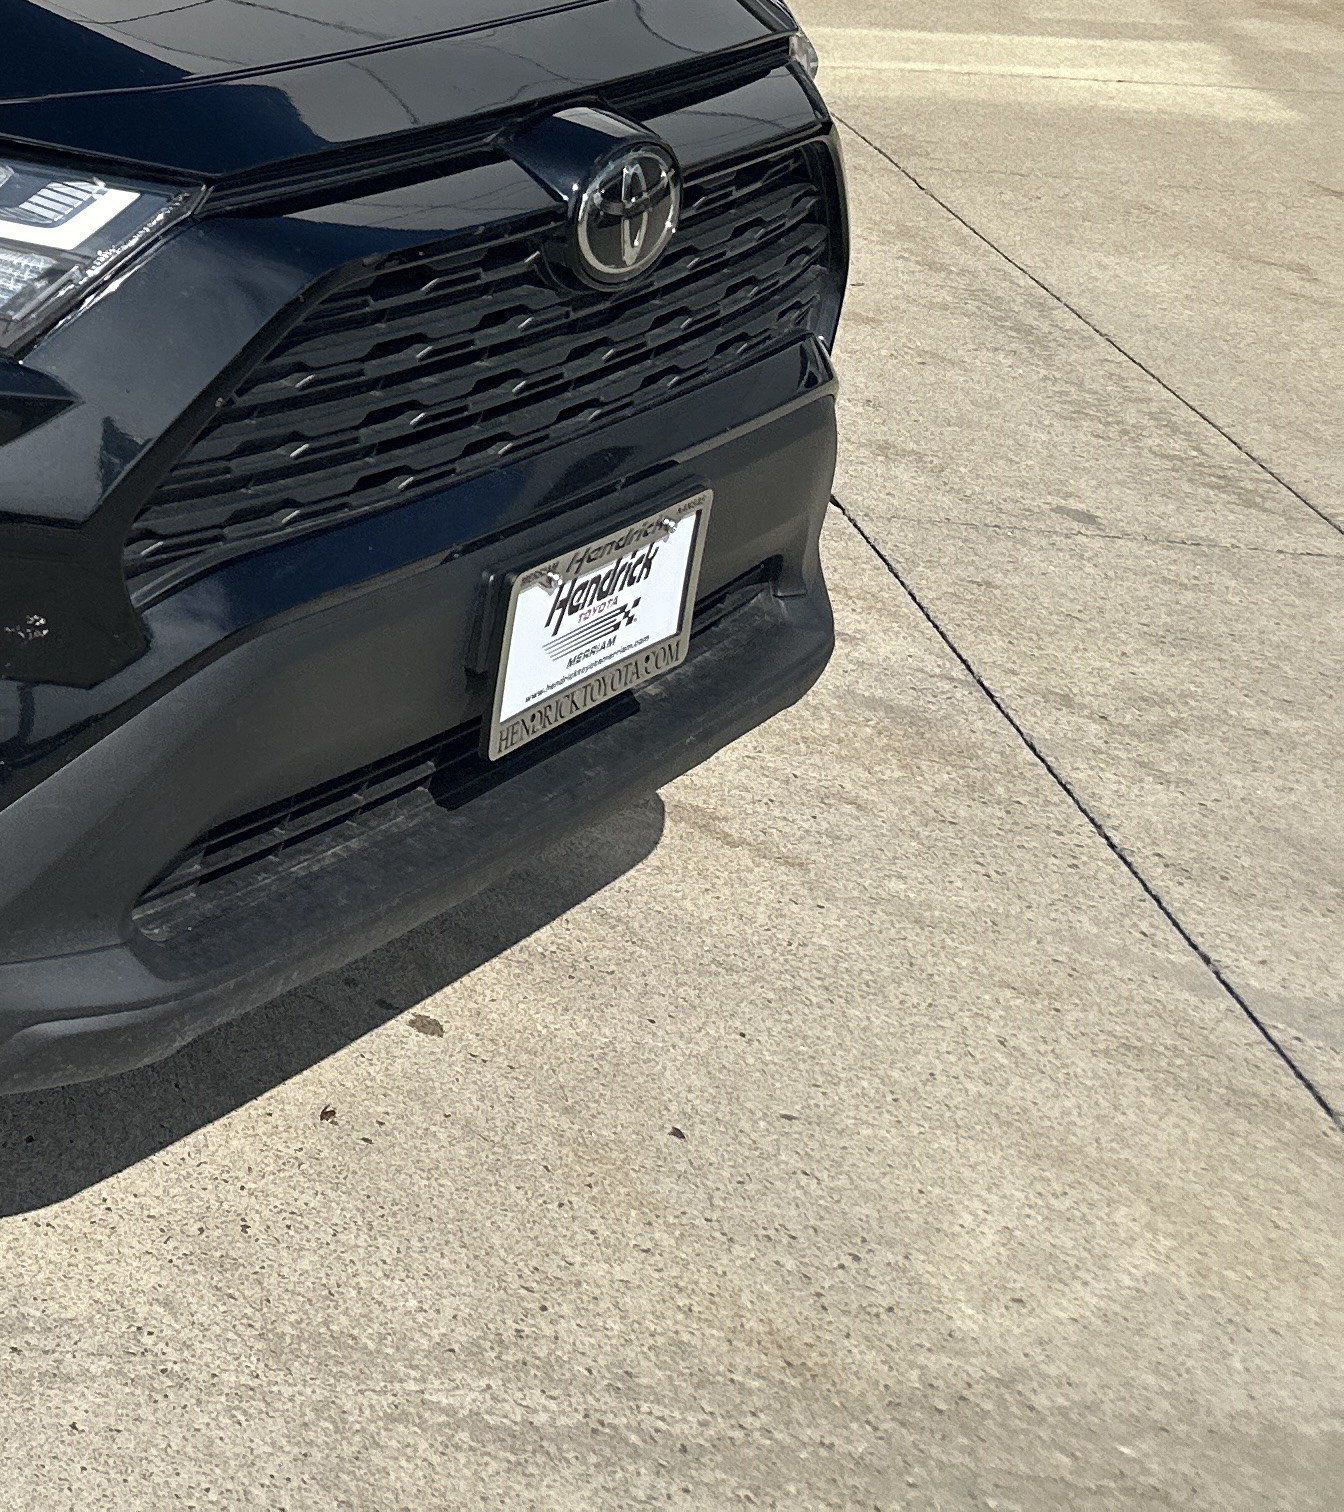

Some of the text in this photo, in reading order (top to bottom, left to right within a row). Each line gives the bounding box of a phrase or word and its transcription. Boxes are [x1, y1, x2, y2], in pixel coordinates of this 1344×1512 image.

[565, 518, 668, 574] Hendrick
[544, 542, 660, 637] Hendrick
[578, 595, 618, 623] TOYOTA
[566, 635, 617, 669] MERRIAM
